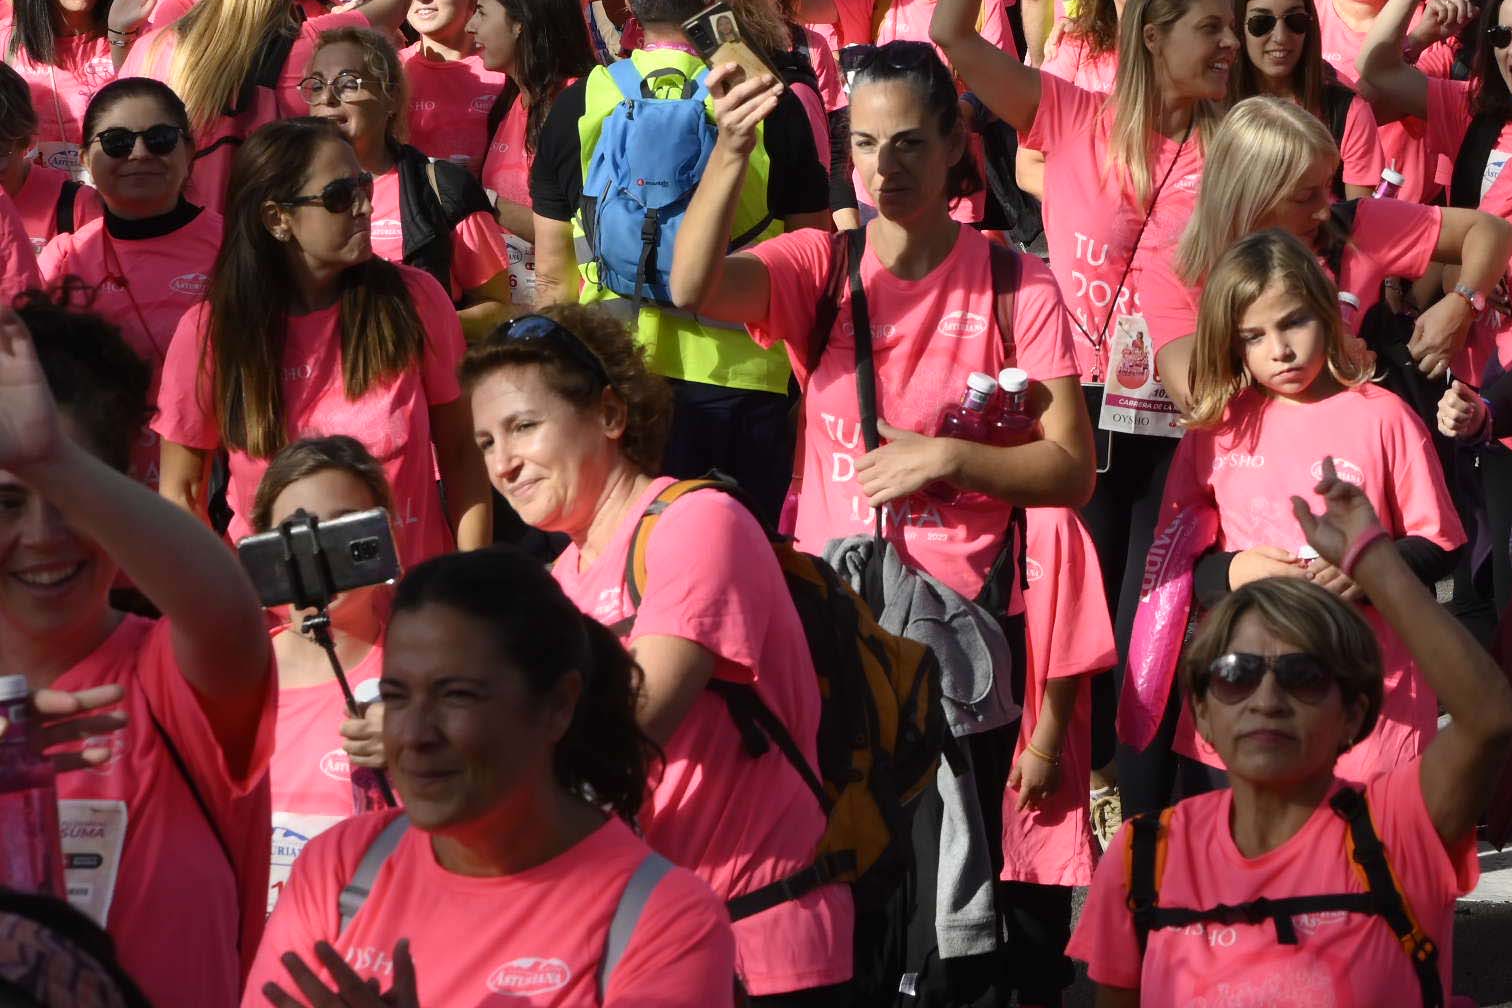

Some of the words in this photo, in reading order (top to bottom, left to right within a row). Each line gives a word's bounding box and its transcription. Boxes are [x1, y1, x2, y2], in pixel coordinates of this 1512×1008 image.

[1074, 232, 1109, 267] TU
[820, 412, 861, 449] TU
[1112, 412, 1150, 427] OYSHO
